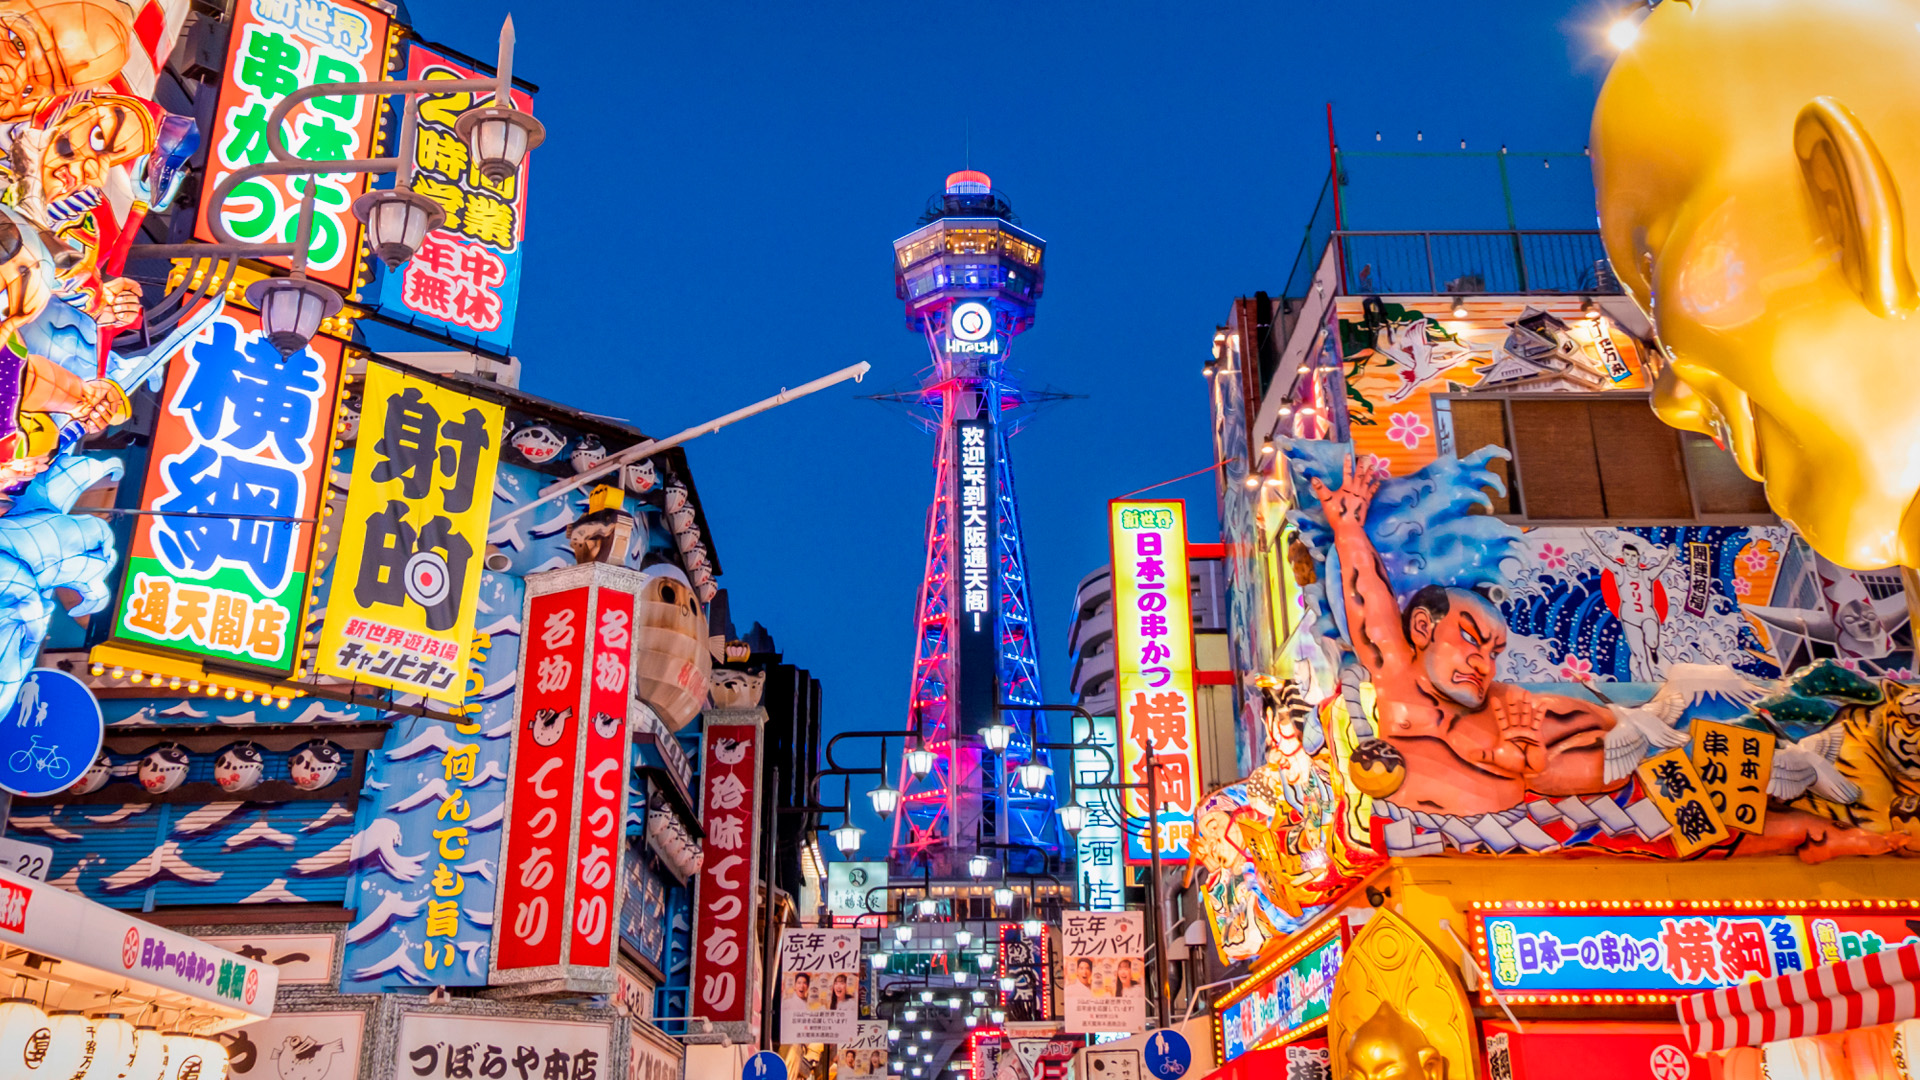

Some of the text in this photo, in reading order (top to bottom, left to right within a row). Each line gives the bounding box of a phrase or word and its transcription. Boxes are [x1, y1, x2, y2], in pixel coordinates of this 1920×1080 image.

[221, 30, 301, 239] 串かつ
[285, 54, 360, 265] 日本一の
[409, 270, 497, 326] 無休
[946, 338, 999, 355] HITACHI
[158, 320, 319, 590] 横綱
[353, 386, 490, 631] 射的
[1121, 509, 1174, 530] 新世界
[128, 579, 289, 658] 通天閣店
[1135, 532, 1172, 688] 日本一の串かつ
[337, 642, 456, 690] チャンピオン
[345, 617, 460, 662] 新世界遊技場
[513, 607, 576, 947] 名物 てっちり
[576, 608, 630, 946] 名物 てっちり
[1129, 692, 1191, 813] 横綱
[1699, 730, 1730, 814] 串かつ
[1735, 737, 1761, 825] 日本一の
[784, 932, 826, 953] 忘年
[1064, 915, 1108, 937] 忘年
[1069, 933, 1143, 957] カンパイ!
[1493, 923, 1520, 983] 新世界
[1518, 920, 1772, 982] 日本一の串かつ 横綱
[1769, 922, 1803, 977] 名門
[1814, 922, 1842, 965] 新世
[141, 937, 216, 988] 日本一の串かつ
[788, 950, 858, 972] カンパイ!
[409, 1041, 599, 1080] づぼらや本店
